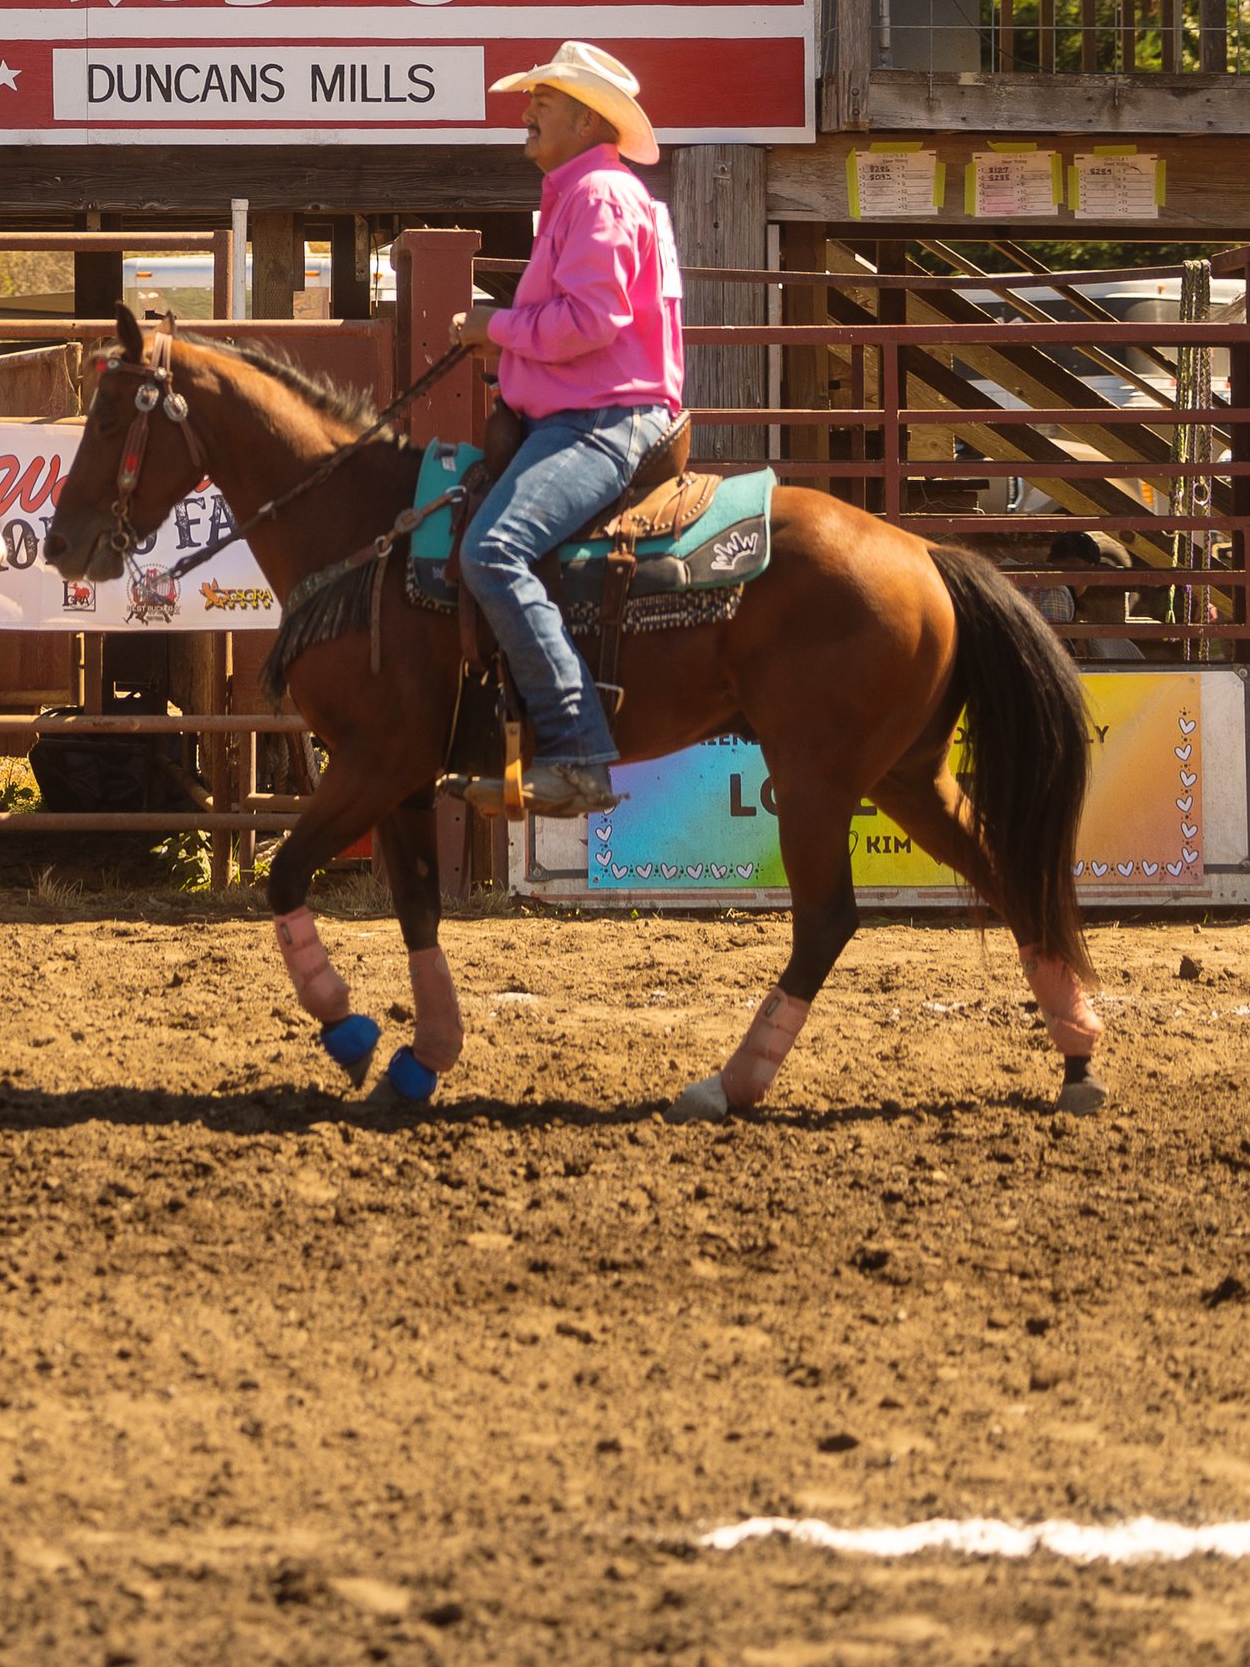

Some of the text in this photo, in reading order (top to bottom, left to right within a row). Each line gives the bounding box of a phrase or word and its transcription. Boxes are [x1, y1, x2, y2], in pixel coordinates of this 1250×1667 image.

[87, 63, 436, 103] DUNCANS MILLS
[866, 836, 912, 854] KIM
